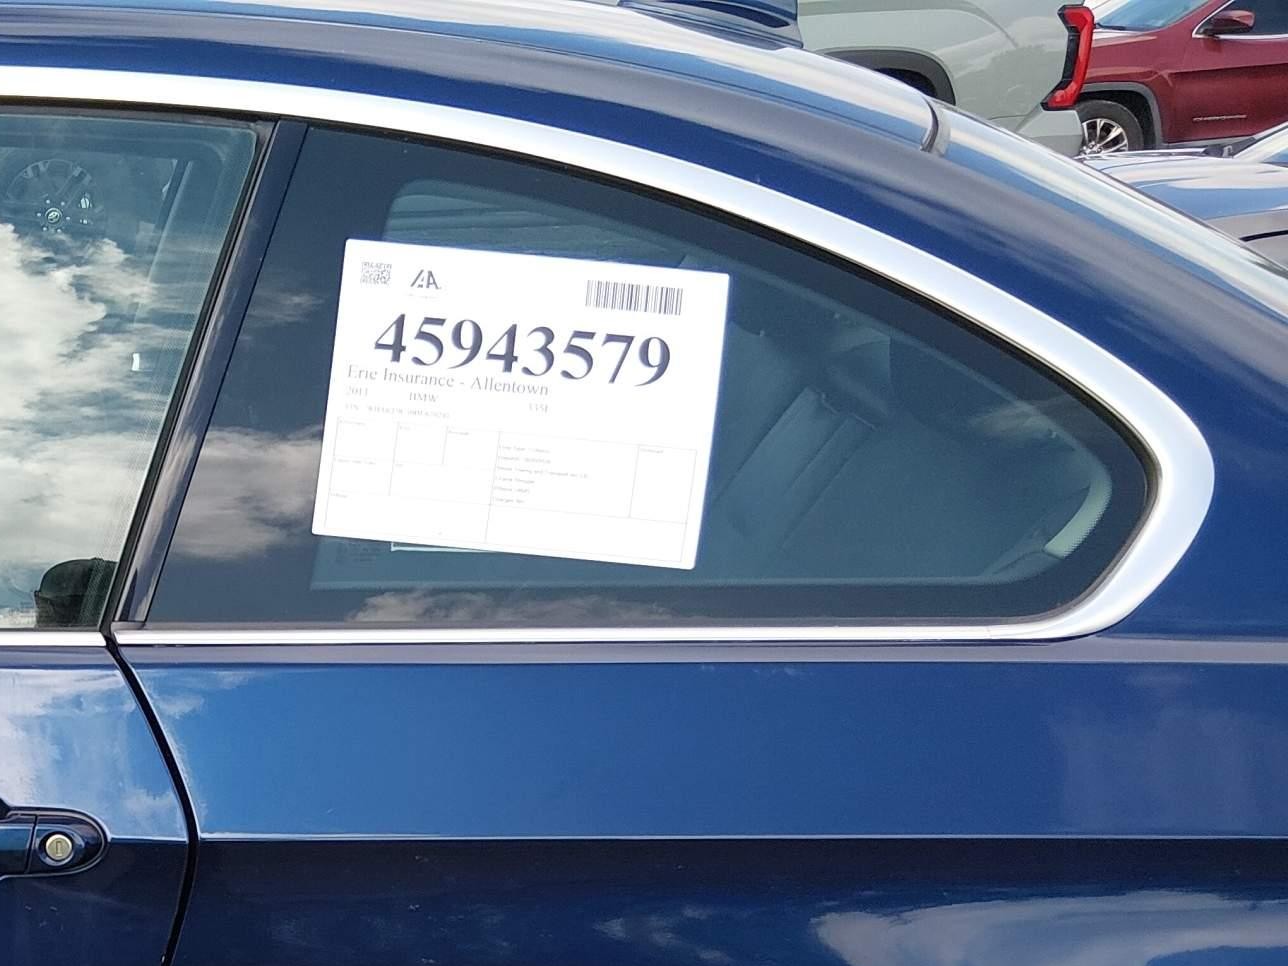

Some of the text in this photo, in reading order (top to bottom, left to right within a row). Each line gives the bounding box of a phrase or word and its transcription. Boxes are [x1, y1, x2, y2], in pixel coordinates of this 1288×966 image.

[374, 312, 672, 388] 45943579
[347, 364, 378, 381] Erie
[383, 367, 455, 388] Insurance
[470, 374, 549, 396] Allentown
